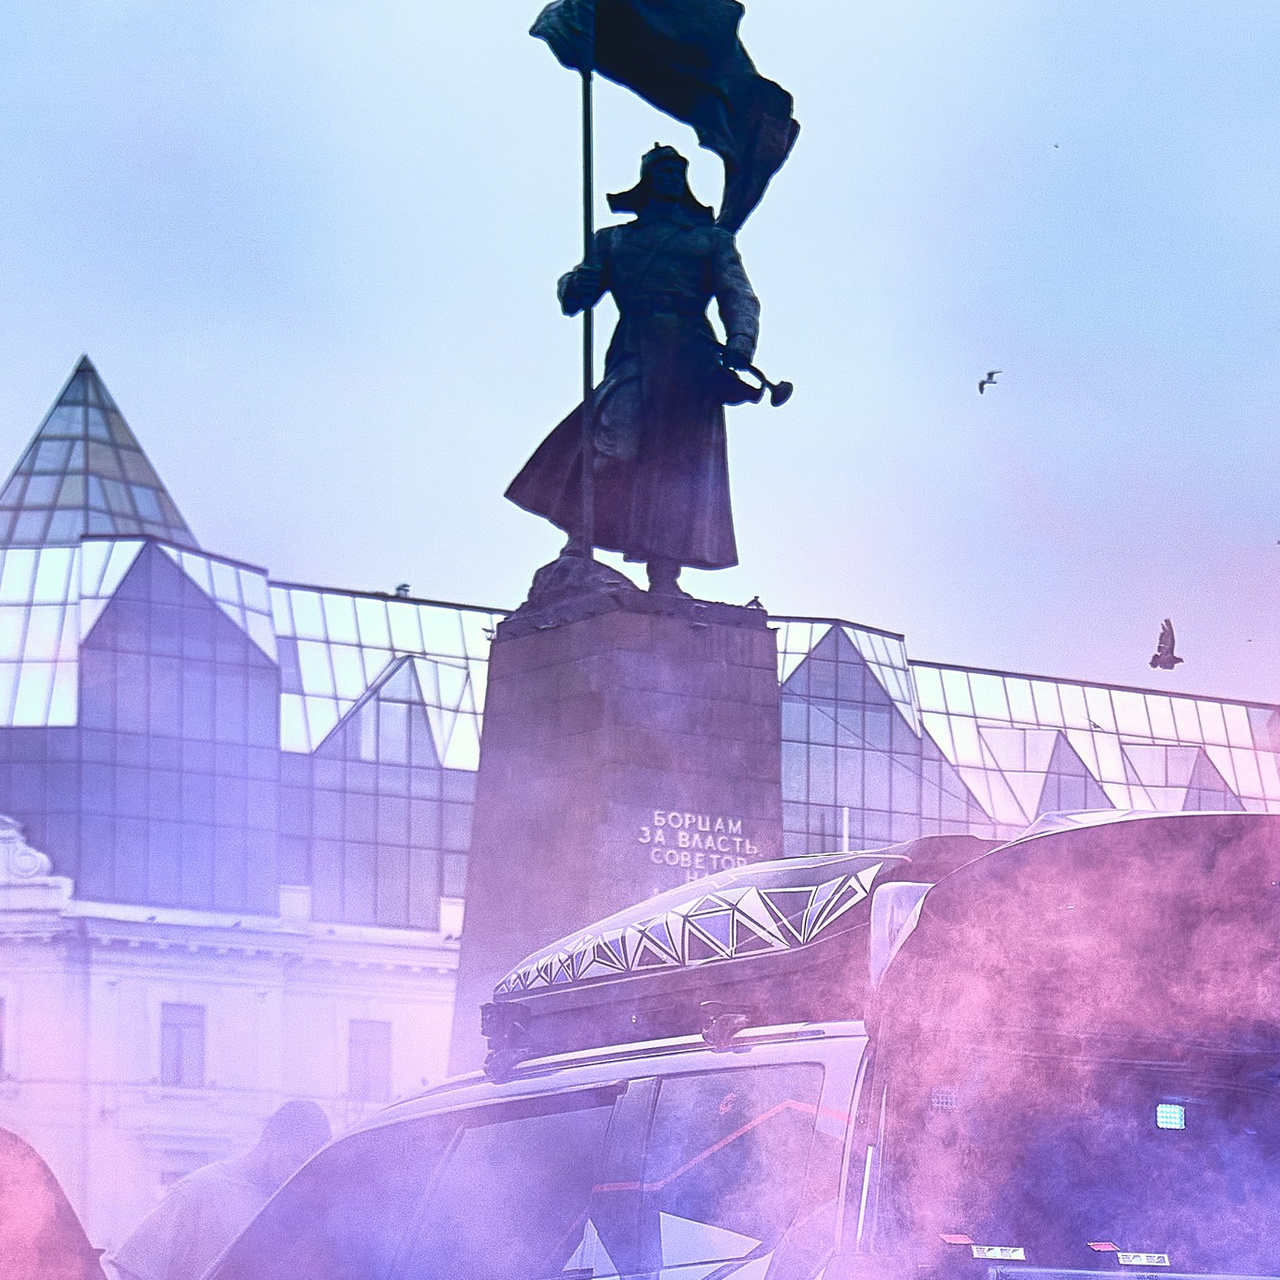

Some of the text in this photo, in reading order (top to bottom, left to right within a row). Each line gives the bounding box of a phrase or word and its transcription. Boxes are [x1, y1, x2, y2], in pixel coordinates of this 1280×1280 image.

[654, 810, 742, 834] БОРЦАМ
[638, 827, 757, 855] ЗА ВЛАСТЬ
[651, 849, 748, 870] СОВЕТОВ
